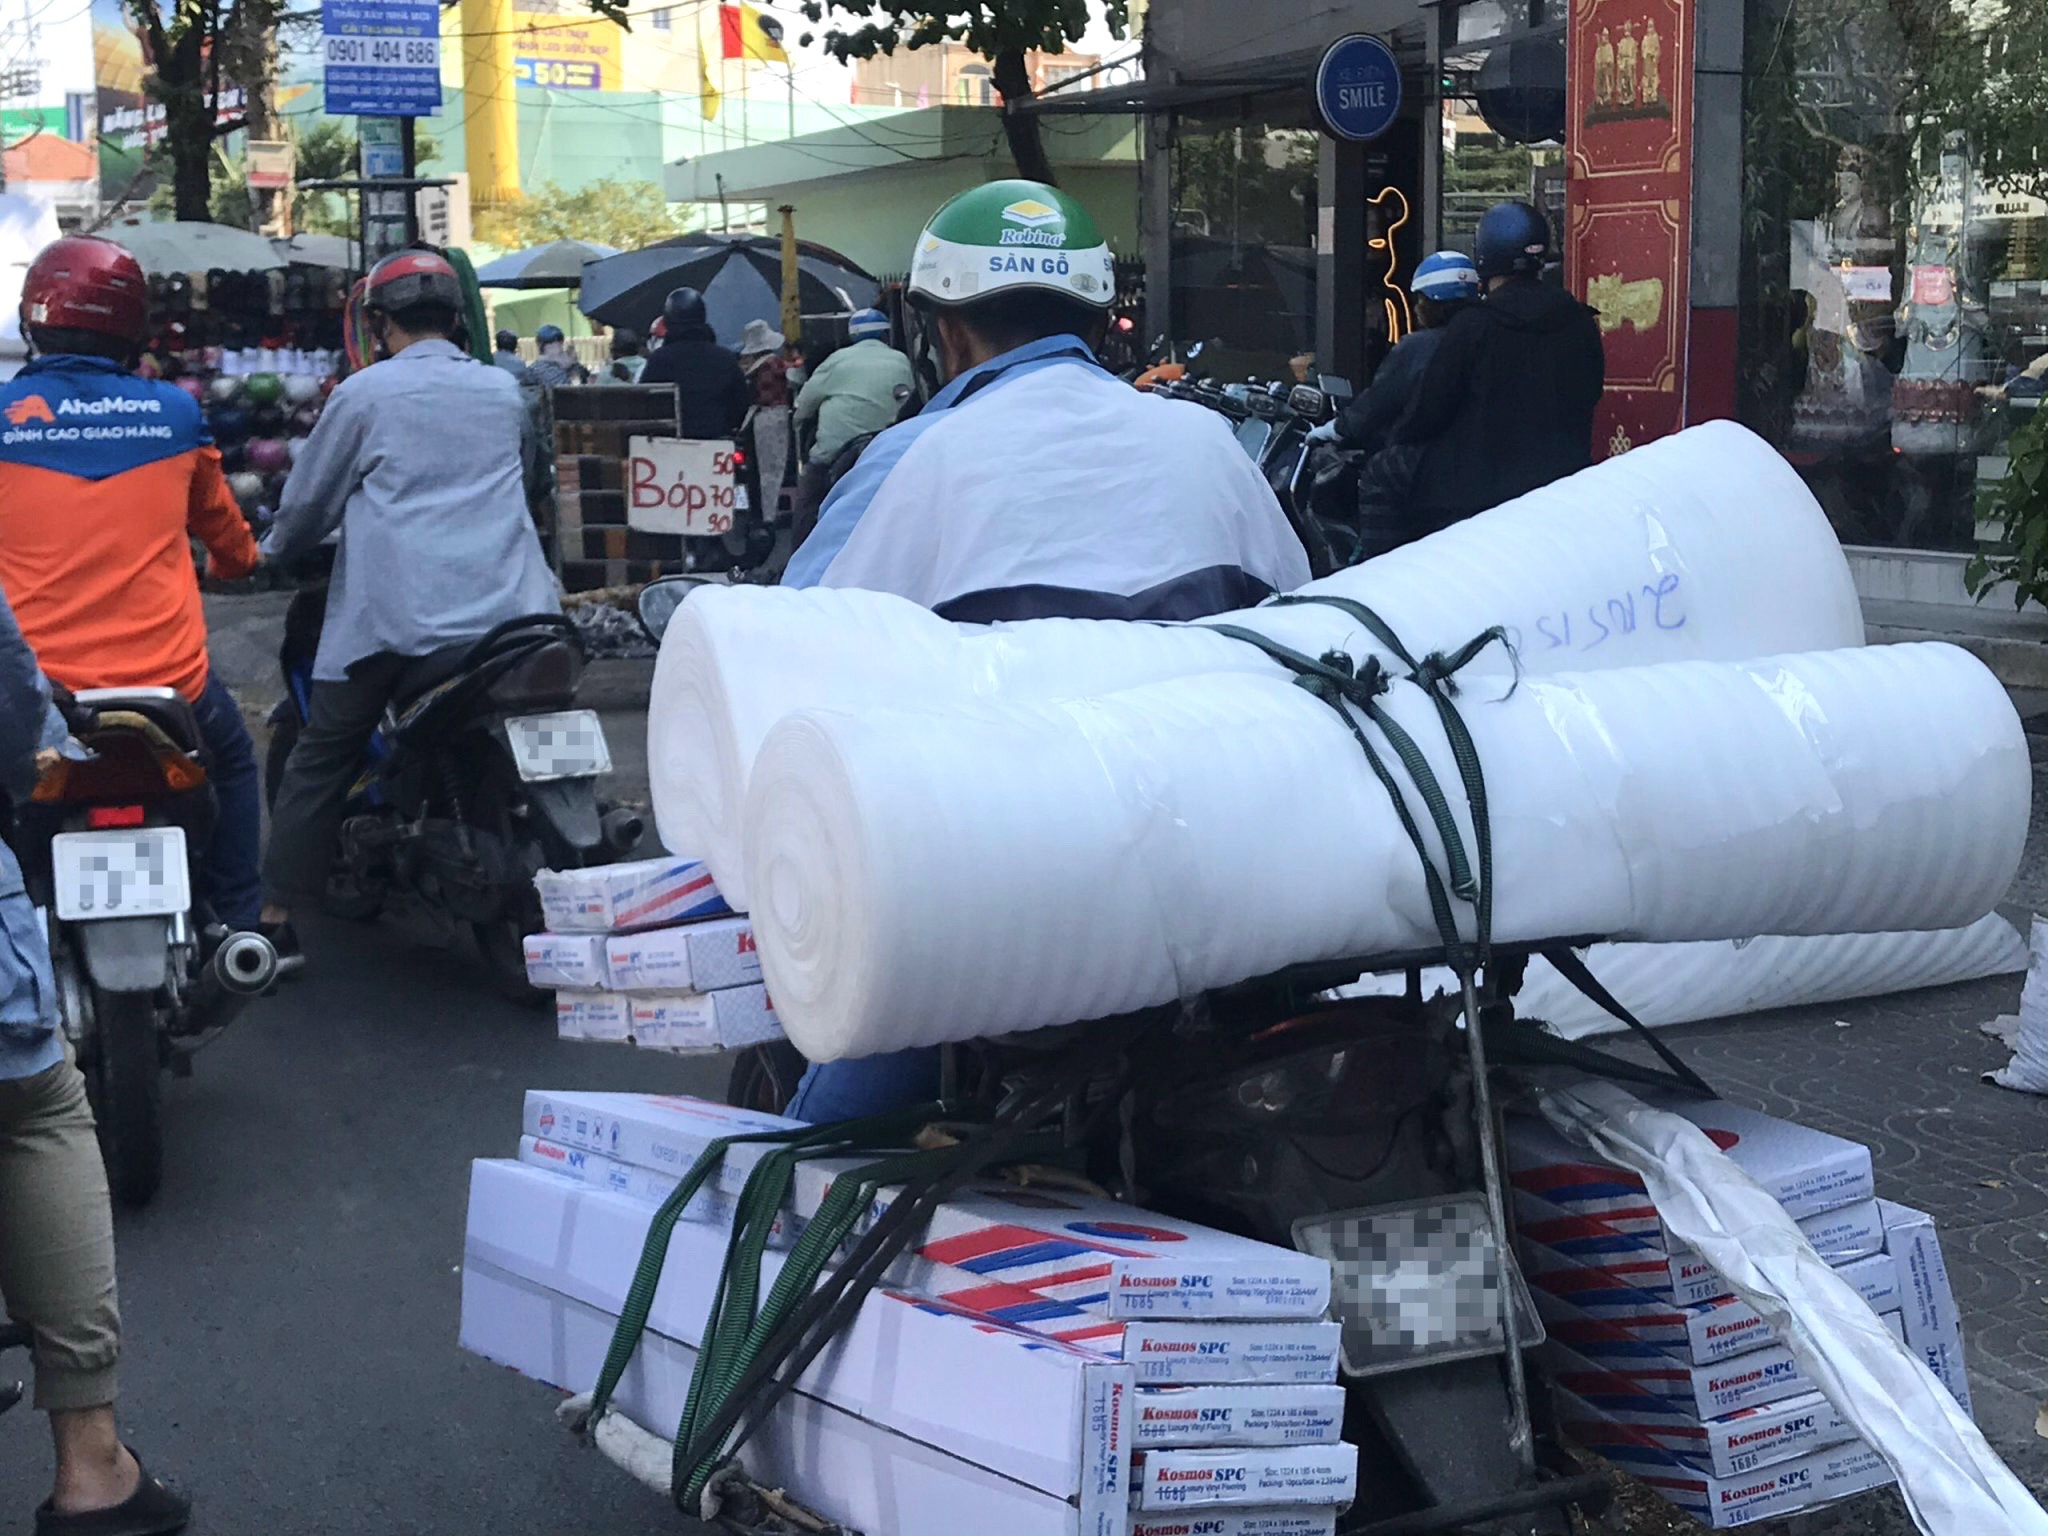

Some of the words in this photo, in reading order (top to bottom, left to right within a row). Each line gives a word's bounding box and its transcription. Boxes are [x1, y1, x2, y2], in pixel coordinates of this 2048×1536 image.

[328, 39, 365, 61] 0901
[372, 40, 400, 62] 404
[406, 41, 434, 63] 686
[1339, 86, 1387, 110] SMILE
[1000, 229, 1066, 247] Robina
[989, 252, 1035, 272] SÀN
[1042, 252, 1069, 275] GỖ
[57, 396, 162, 415] AhaMove
[45, 428, 81, 441] CAO
[82, 427, 124, 440] GIAO
[125, 422, 173, 439] HÀNG
[712, 451, 735, 475] 50
[631, 457, 707, 526] Bóp
[709, 485, 735, 508] 70
[1120, 1273, 1177, 1288] Kosmos
[1180, 1275, 1214, 1288] SPC
[1681, 1262, 1708, 1279] Kos
[1706, 1316, 1761, 1339] Kosmos
[1140, 1338, 1197, 1352] Kosmos
[1198, 1342, 1230, 1354] SPC
[1708, 1369, 1763, 1392] Kosmos
[1763, 1359, 1794, 1377] SPC
[1110, 1382, 1123, 1452] Kosmos
[1142, 1406, 1199, 1421] Kosmos
[1200, 1407, 1233, 1421] SPC
[1727, 1425, 1783, 1448] Kosmos
[1783, 1415, 1815, 1434] SPC
[1106, 1453, 1118, 1494] SPC
[1157, 1467, 1213, 1482] Kosmos
[1214, 1467, 1246, 1481] SPC
[1720, 1478, 1776, 1503] Kosmos
[1779, 1468, 1810, 1487] SPC
[1133, 1523, 1189, 1536] Kosmos
[1192, 1520, 1226, 1535] SPC
